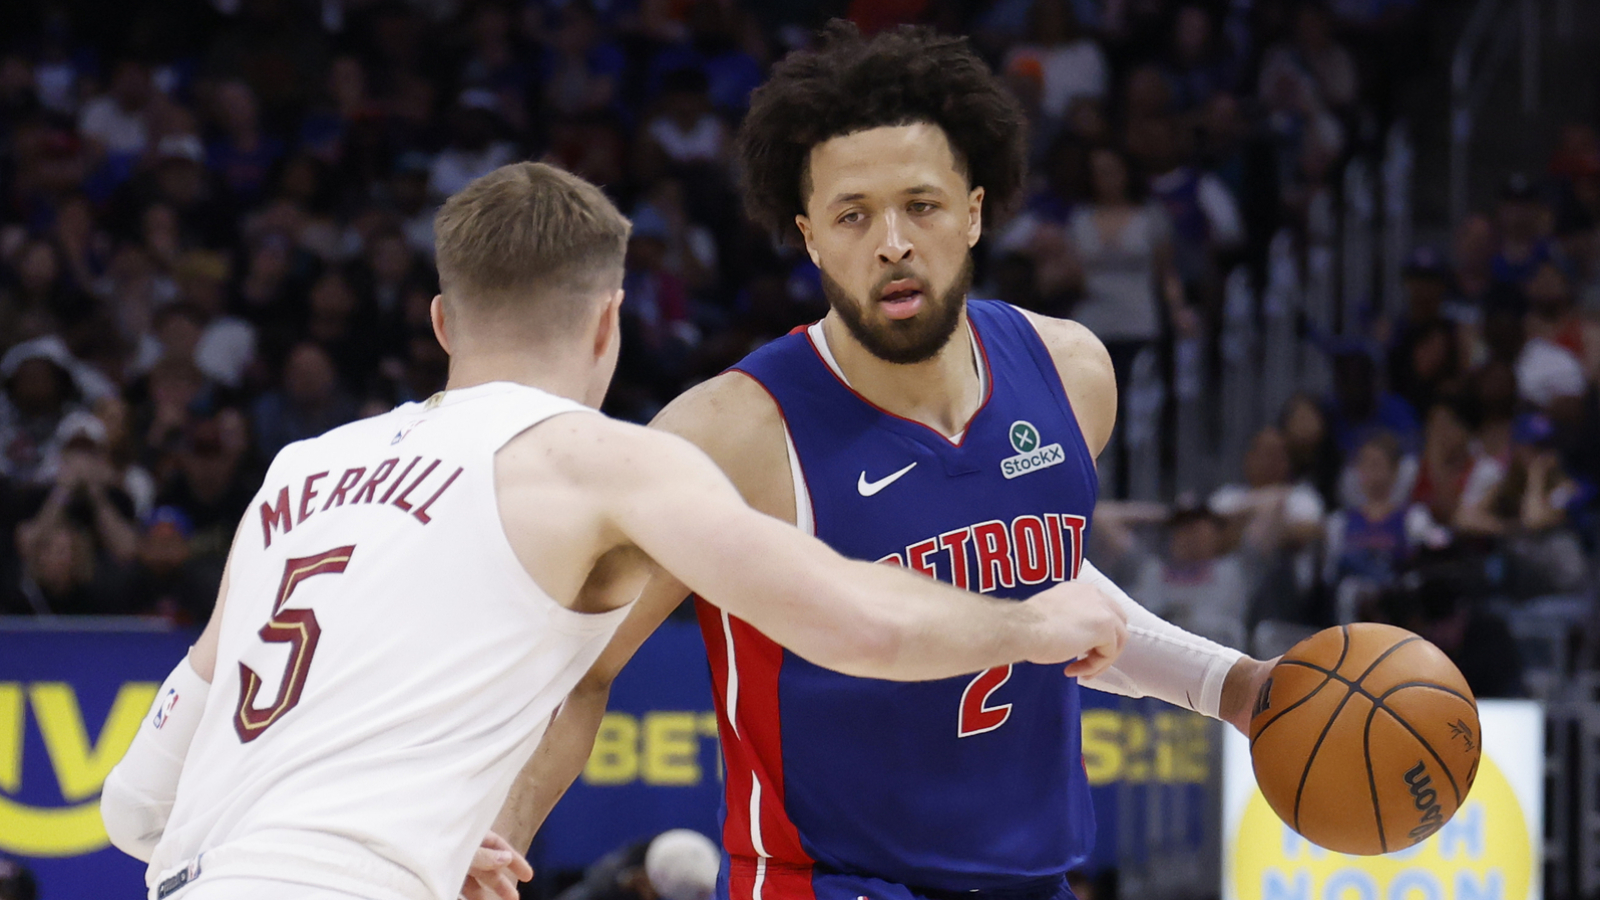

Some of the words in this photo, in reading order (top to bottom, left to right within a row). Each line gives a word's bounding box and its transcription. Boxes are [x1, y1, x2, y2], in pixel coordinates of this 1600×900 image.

[1003, 446, 1063, 476] StockX
[259, 456, 464, 550] MERRILL
[873, 513, 1087, 593] ETROIT
[233, 543, 358, 745] 5
[957, 662, 1013, 738] 2
